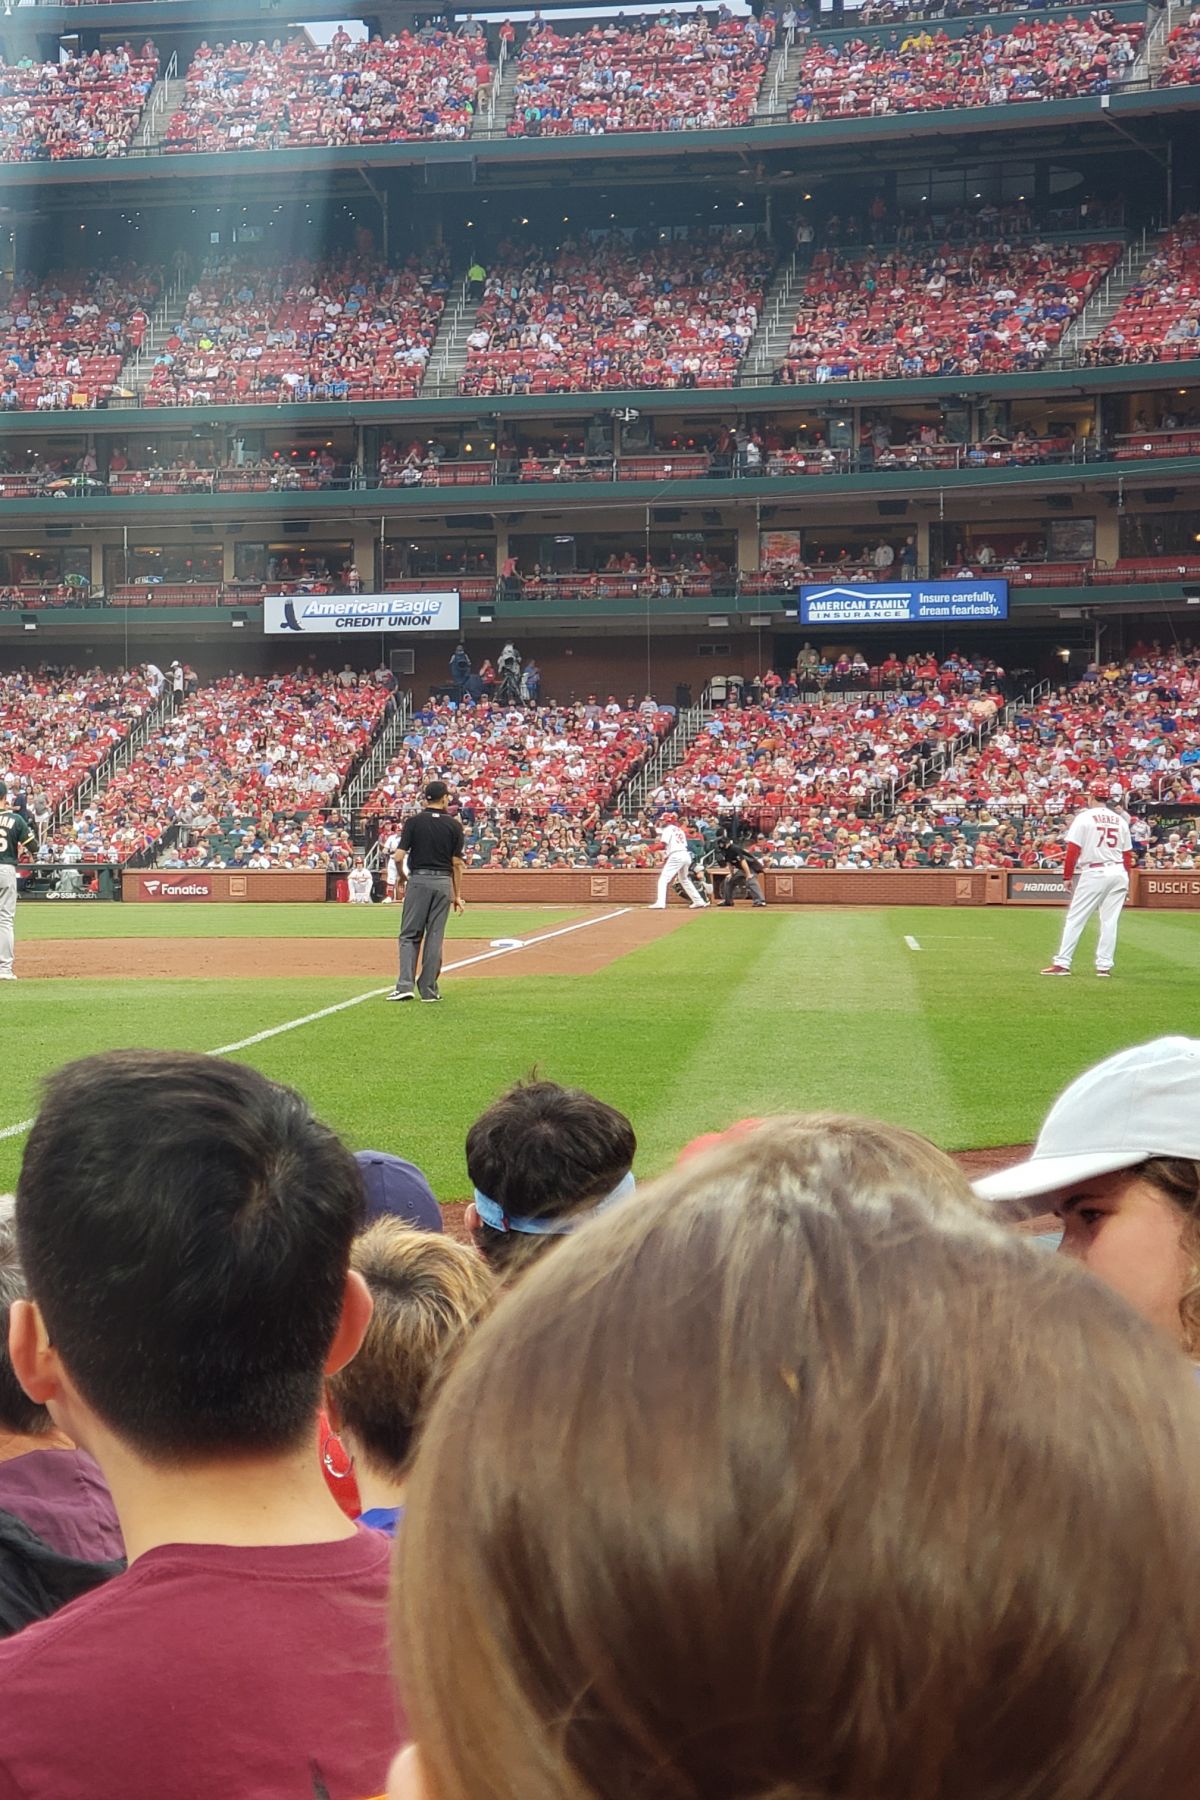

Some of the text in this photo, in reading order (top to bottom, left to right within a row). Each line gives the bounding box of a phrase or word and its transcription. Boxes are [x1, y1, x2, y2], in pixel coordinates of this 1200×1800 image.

[919, 591, 997, 604] Insure carefully,
[305, 598, 441, 617] American Eagle
[808, 599, 910, 611] AMERICAN FAMILY
[919, 604, 1001, 617] dream fearlessly.
[817, 610, 902, 619] INSURANCE
[335, 615, 432, 628] CREDIT UNION
[1096, 826, 1119, 848] 75
[161, 884, 209, 895] Fanatics
[1148, 881, 1188, 894] BUSCH
